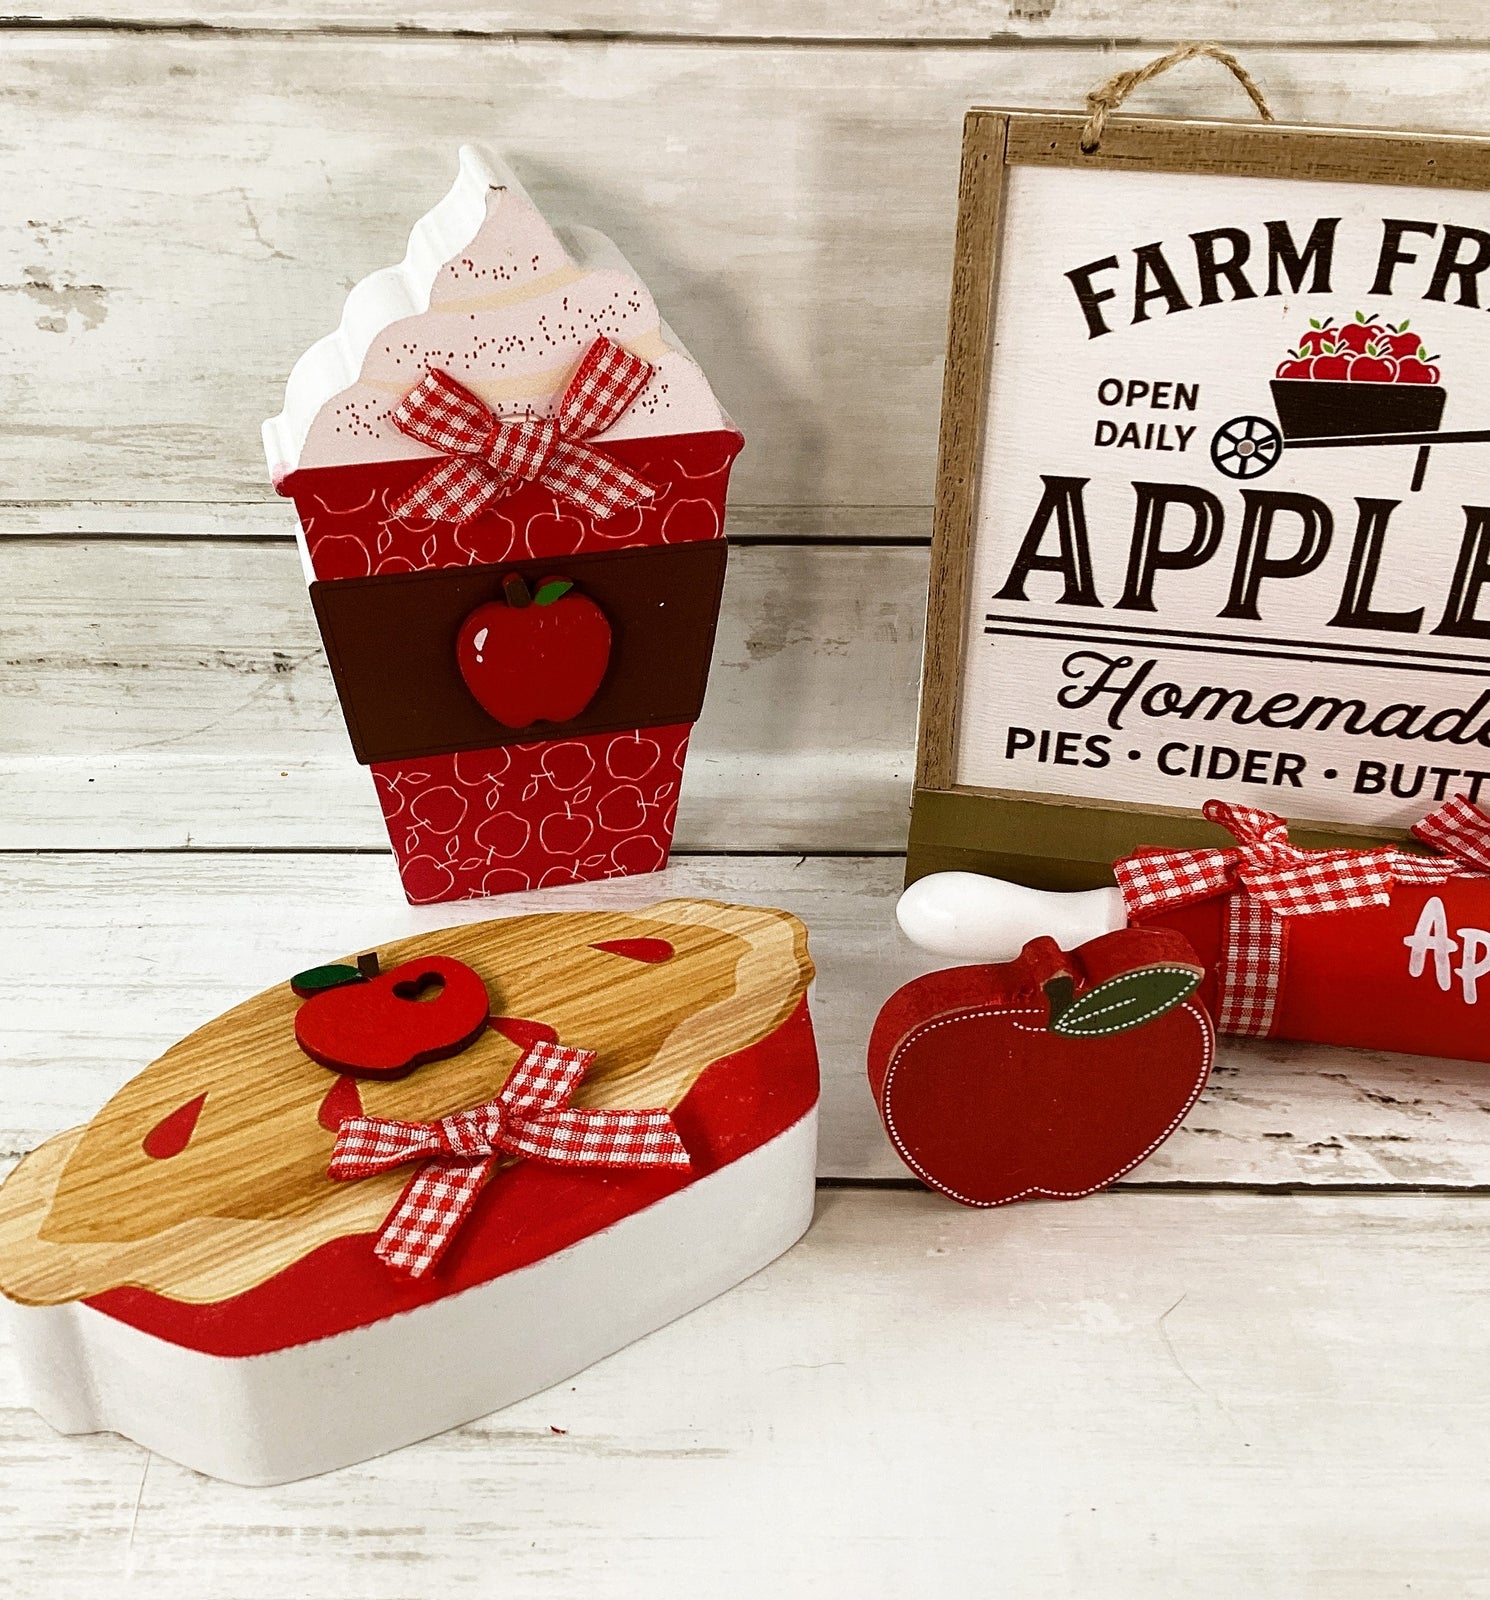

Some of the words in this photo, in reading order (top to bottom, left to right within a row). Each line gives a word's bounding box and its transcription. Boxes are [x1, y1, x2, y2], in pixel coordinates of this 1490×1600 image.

[1063, 217, 1342, 339] FARM
[1367, 218, 1490, 311] FR
[1097, 378, 1199, 411] OPEN
[1094, 420, 1196, 453] DAILY
[1005, 727, 1111, 769] PIES
[1156, 741, 1307, 787] CIDER
